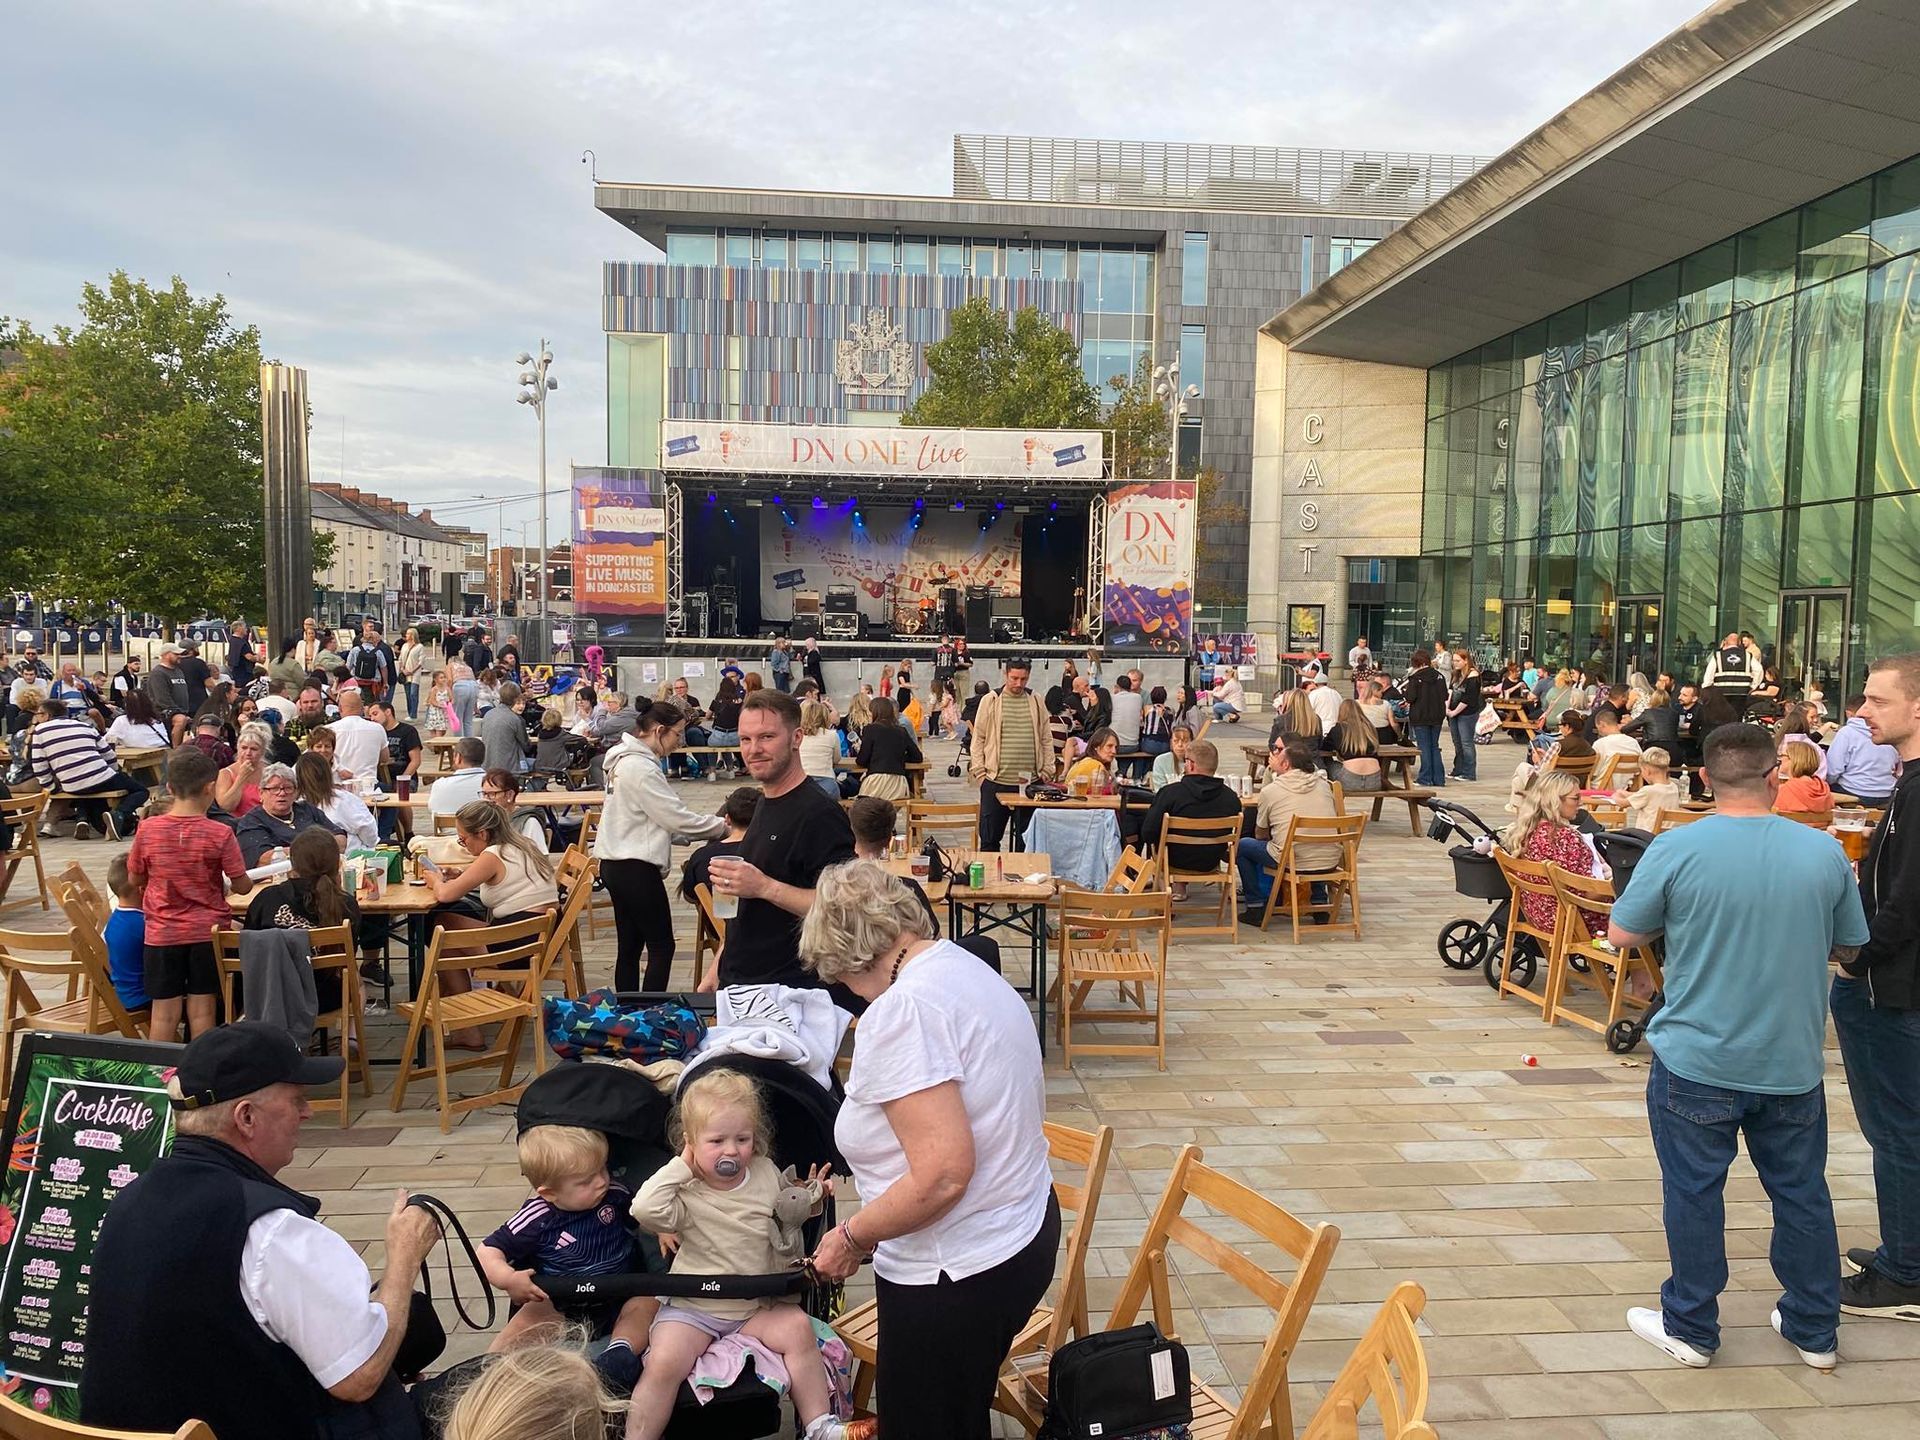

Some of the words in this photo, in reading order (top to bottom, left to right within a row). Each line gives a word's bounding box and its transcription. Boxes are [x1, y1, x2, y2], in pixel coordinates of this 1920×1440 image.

[791, 437, 836, 464] DN
[844, 439, 909, 466] ONE
[917, 435, 968, 471] Live
[1298, 413, 1324, 574] CAST
[641, 514, 660, 526] Live
[1124, 511, 1176, 541] DN
[585, 554, 655, 567] SUPPORTING
[1122, 544, 1176, 565] ONE
[585, 567, 613, 581] LIVE
[615, 568, 655, 581] MUSIC
[585, 582, 596, 593] IN
[597, 582, 655, 594] DONCASTER
[54, 1089, 154, 1130] Cocktails
[575, 1282, 596, 1293] Joie
[701, 1280, 721, 1292] Joie
